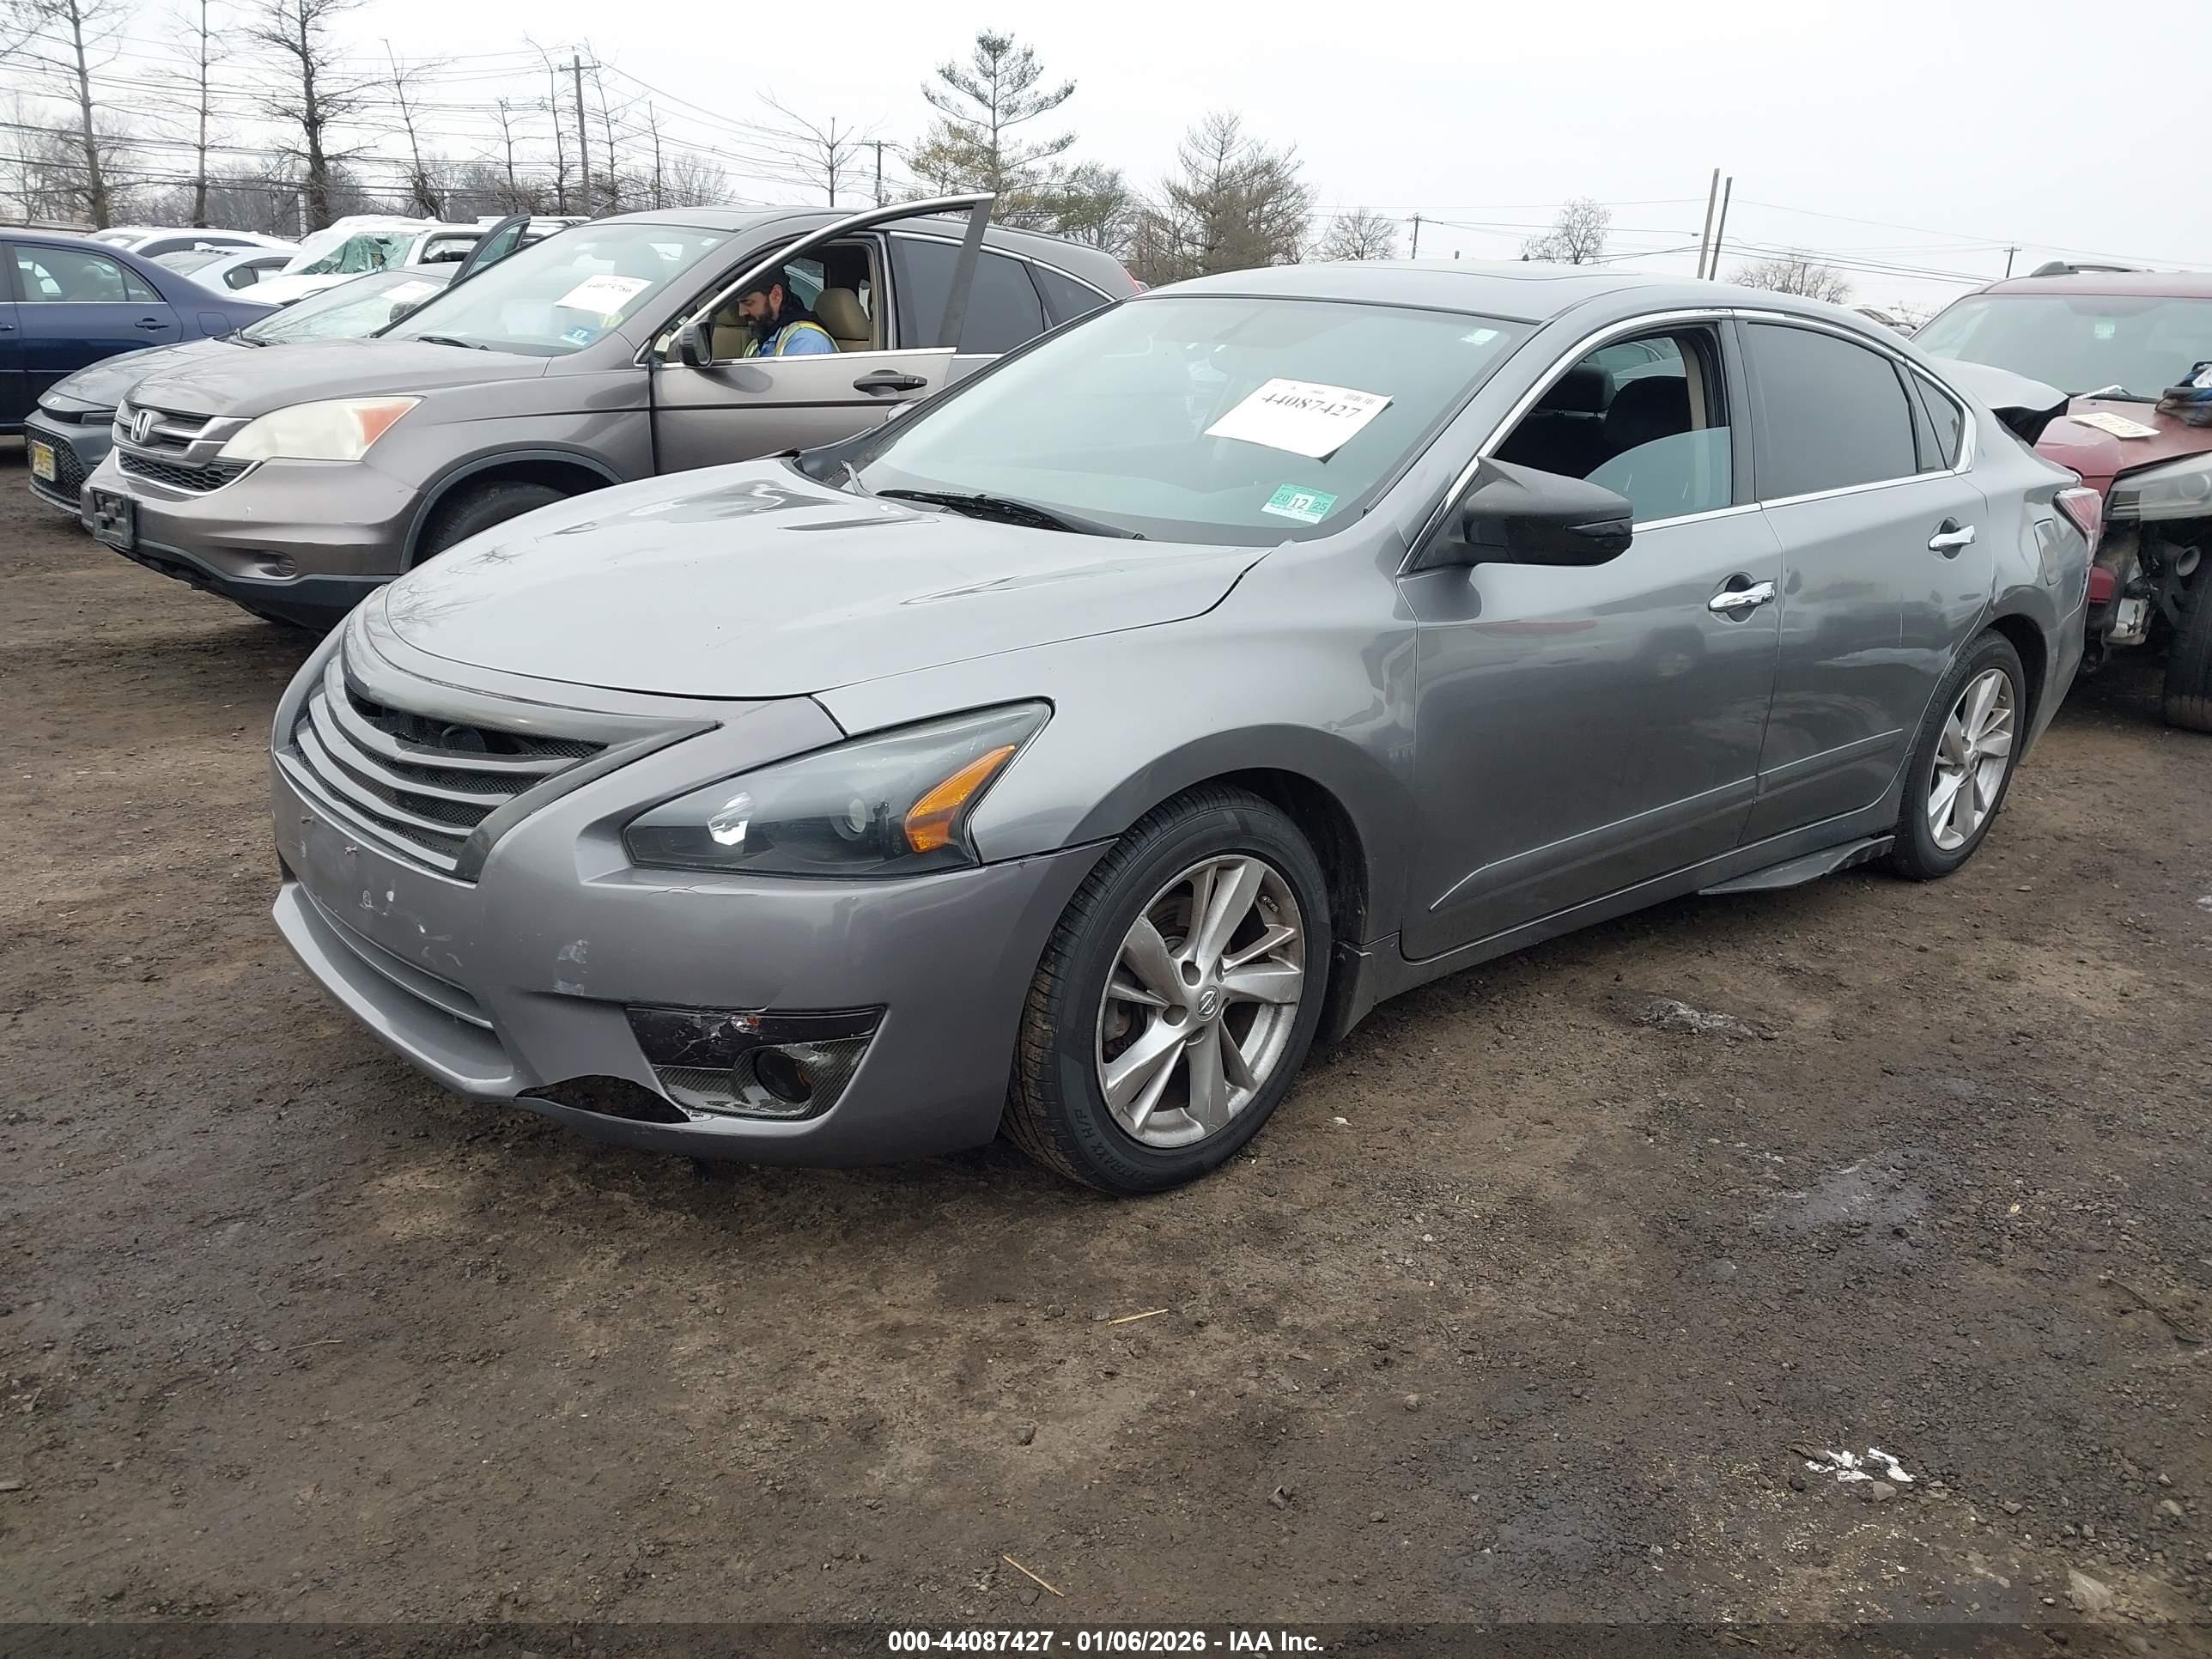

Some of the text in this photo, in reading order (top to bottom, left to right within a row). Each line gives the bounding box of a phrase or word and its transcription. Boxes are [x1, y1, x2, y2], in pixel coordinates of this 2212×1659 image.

[1261, 392, 1362, 418] 44087427
[1275, 493, 1291, 502] 20
[1291, 497, 1309, 509] 12
[1312, 501, 1329, 511] 25
